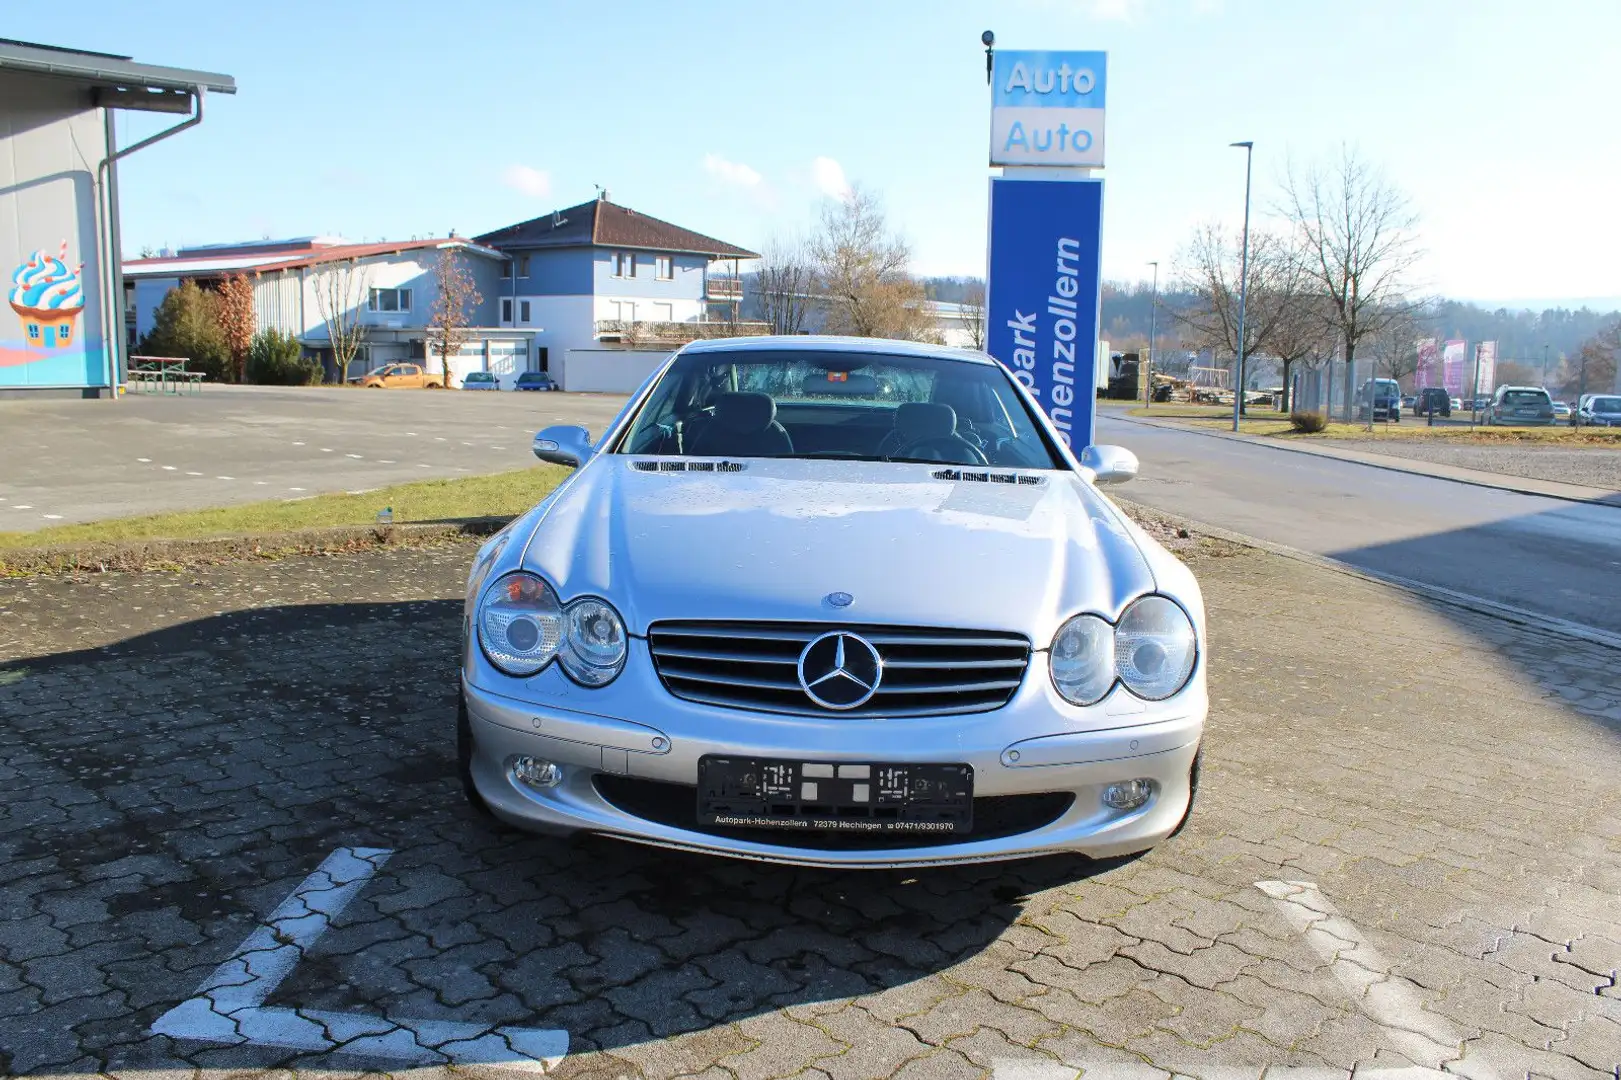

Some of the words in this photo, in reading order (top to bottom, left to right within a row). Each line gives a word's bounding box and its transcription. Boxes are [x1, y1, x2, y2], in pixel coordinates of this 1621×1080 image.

[1004, 60, 1096, 95] Auto
[1004, 120, 1093, 152] Auto
[1007, 308, 1040, 397] park
[715, 815, 808, 827] Autopark-Hohenzollern
[814, 820, 838, 829] 72379
[839, 821, 882, 830] Hechingen
[895, 822, 954, 831] 07471/9301970
